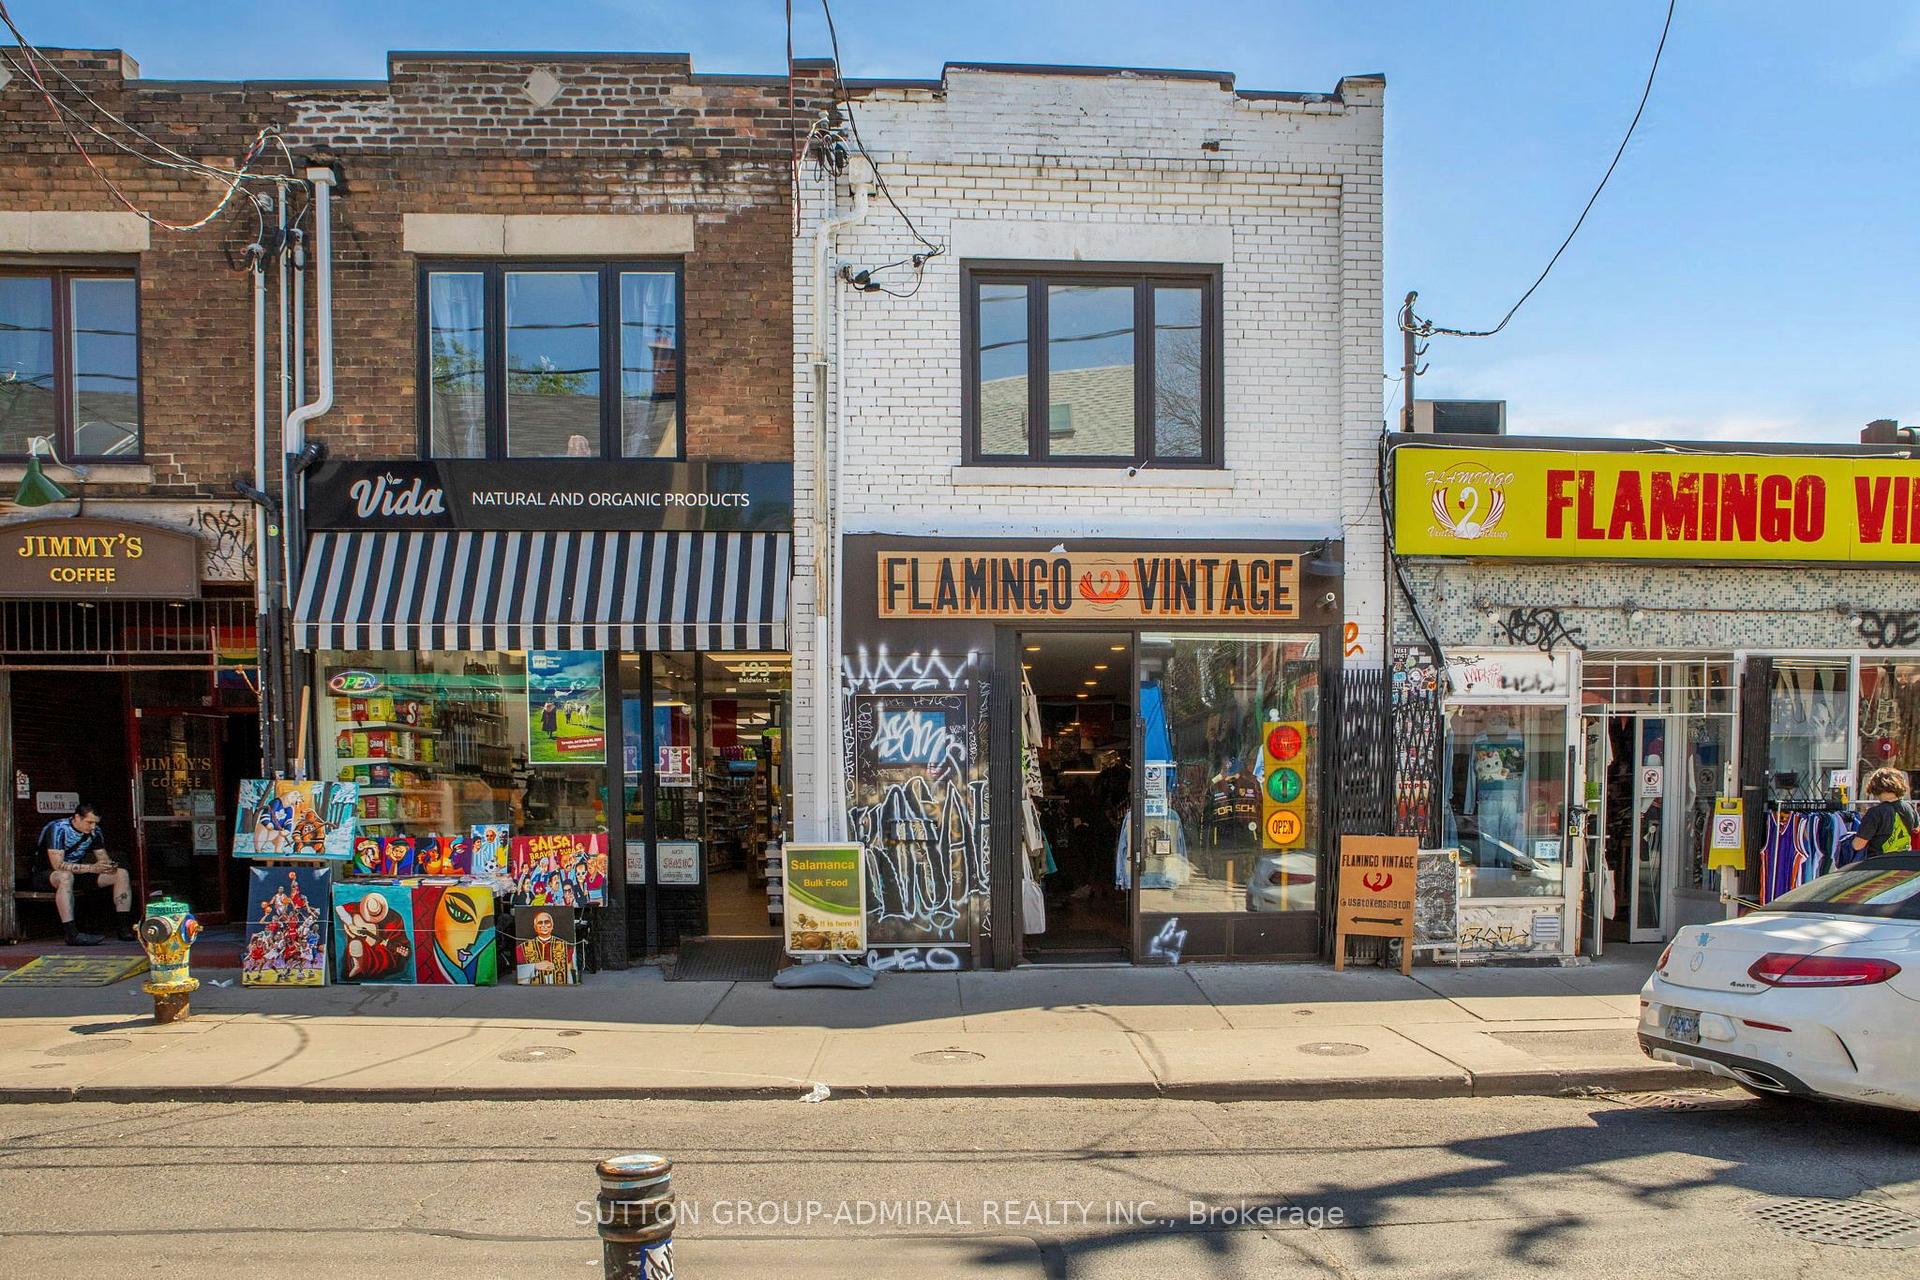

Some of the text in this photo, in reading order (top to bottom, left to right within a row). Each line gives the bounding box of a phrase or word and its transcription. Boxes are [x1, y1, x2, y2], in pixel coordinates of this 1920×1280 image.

[1424, 469, 1515, 488] FLAMINGO
[350, 474, 446, 519] Vida
[472, 491, 750, 508] NATURAL AND ORGANIC PRODUCTS
[1546, 469, 1827, 543] FLAMINGO
[18, 533, 143, 558] JIMMY'S
[50, 567, 116, 582] COFFEE
[883, 557, 1294, 615] FLAMINGO VINTAGE
[739, 661, 770, 677] 193
[330, 676, 376, 690] OPEN
[142, 757, 212, 771] JIMMY'S
[151, 777, 202, 788] COFFEE
[1272, 820, 1295, 834] OPEN
[529, 835, 571, 853] SALSA
[791, 860, 855, 870] Salamanca
[1341, 855, 1415, 868] FLAMINGO VINTAGE
[803, 879, 848, 887] Bulk Food
[1730, 981, 1757, 989] 4MATIC
